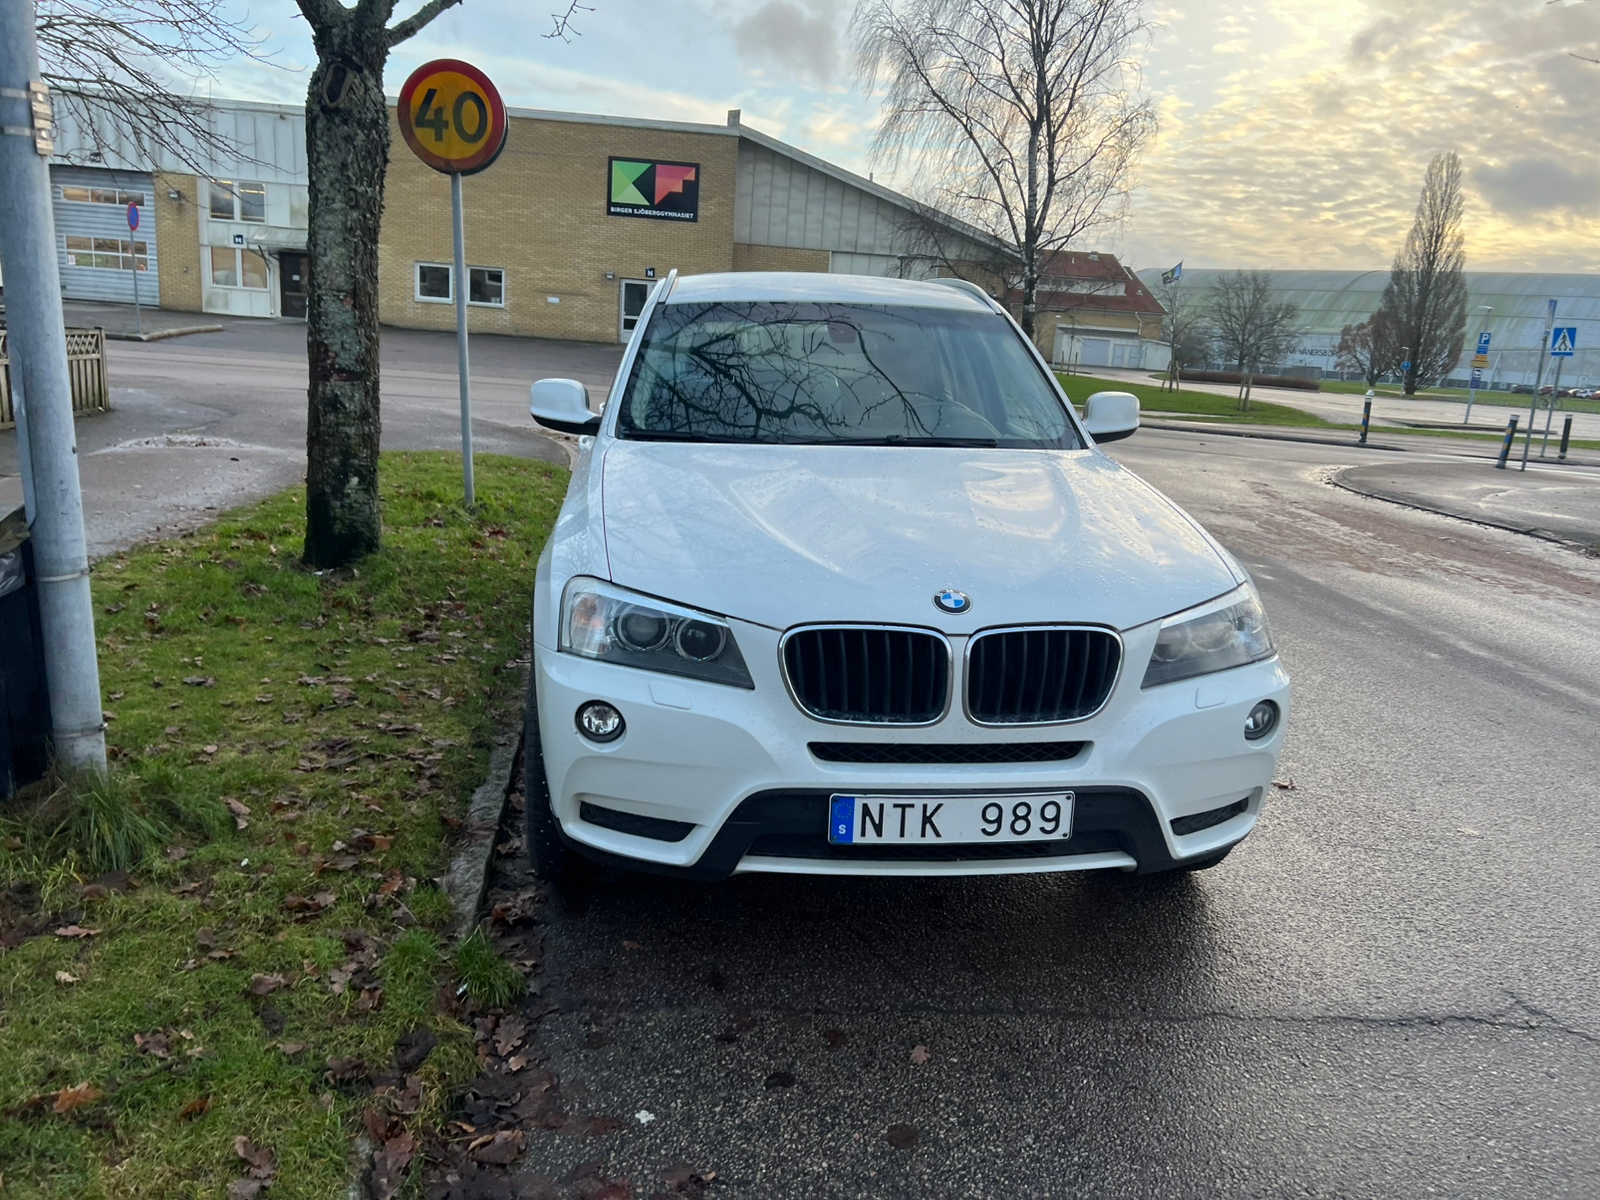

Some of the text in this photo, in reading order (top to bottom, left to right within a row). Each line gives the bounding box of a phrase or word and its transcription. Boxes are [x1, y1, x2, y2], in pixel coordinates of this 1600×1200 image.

[414, 88, 488, 144] 40
[610, 206, 694, 219] BIRGER SJÖBERGGYMNASIET
[1481, 333, 1490, 344] P
[860, 800, 1062, 838] NTK 989
[838, 824, 847, 835] S
